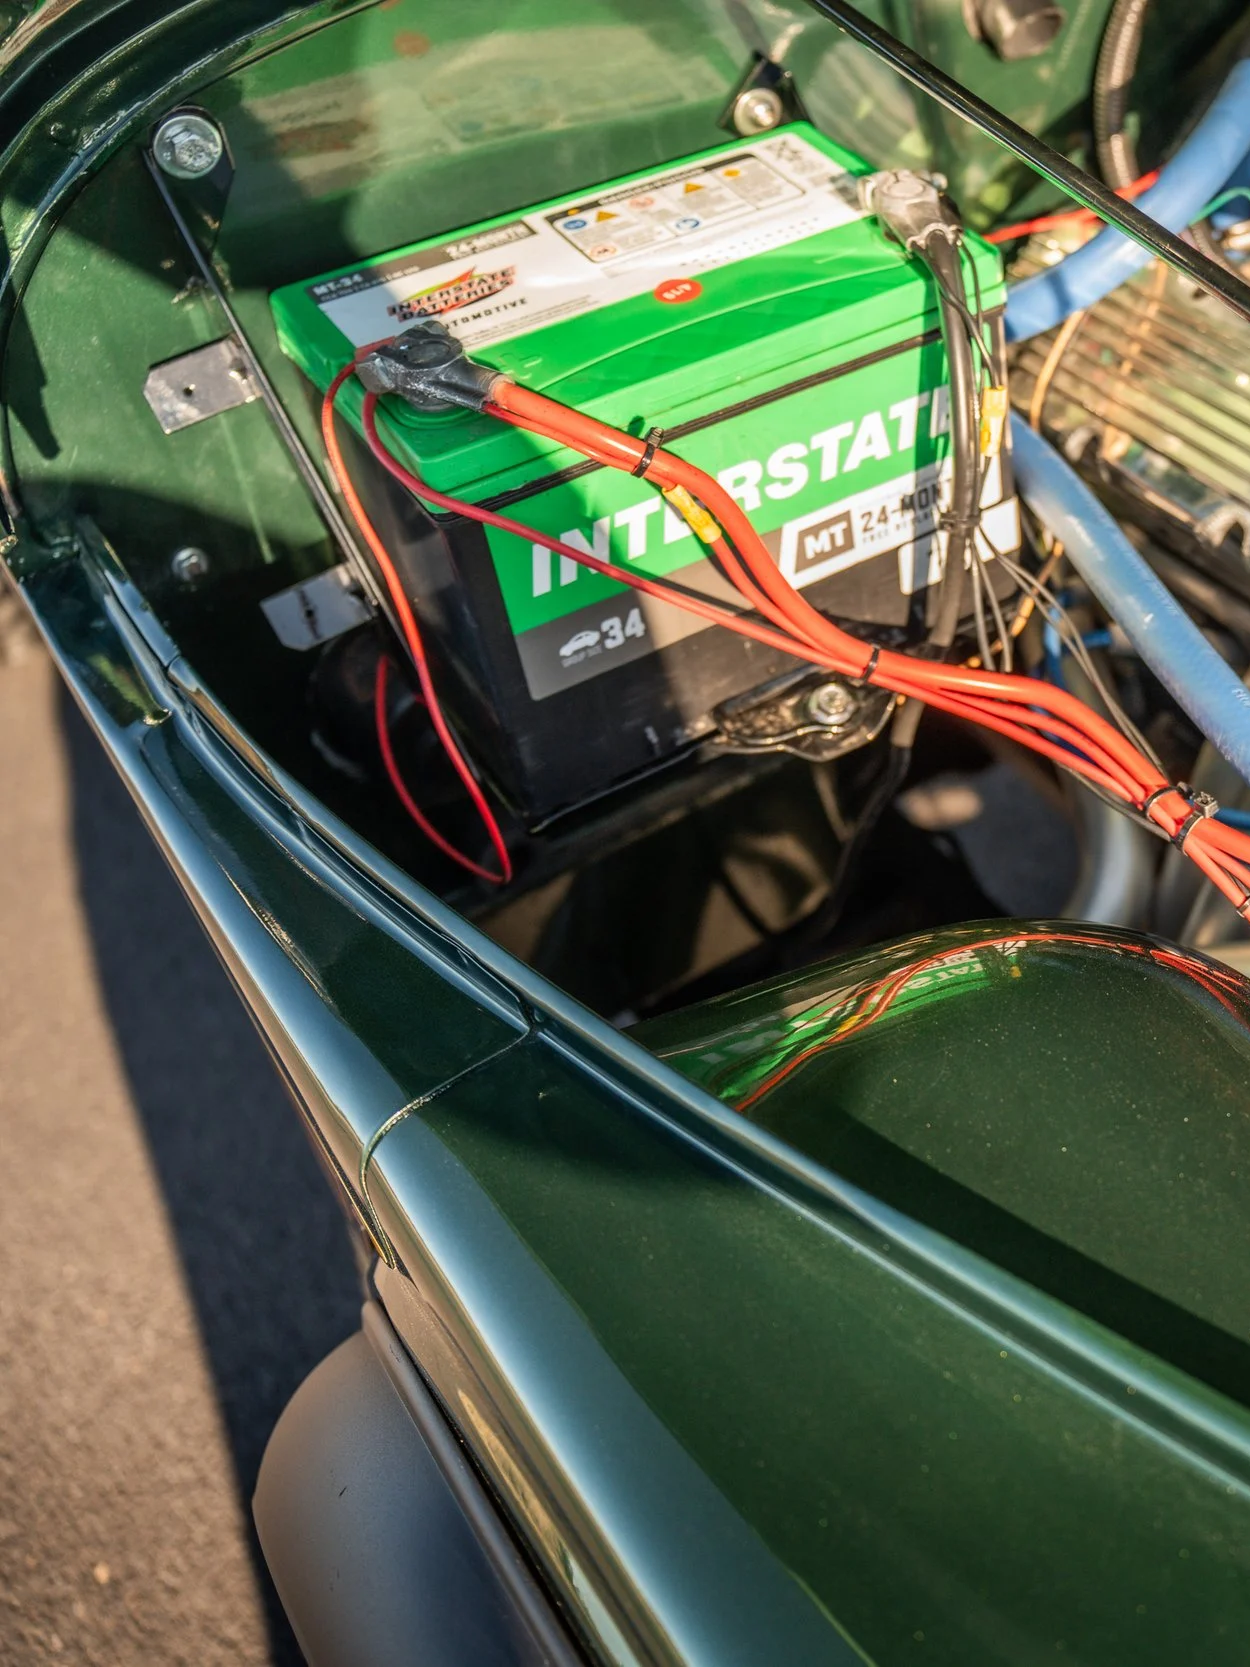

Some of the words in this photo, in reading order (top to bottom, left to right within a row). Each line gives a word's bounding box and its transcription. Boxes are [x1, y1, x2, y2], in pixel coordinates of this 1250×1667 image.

[390, 267, 511, 313] INTERSTATE
[401, 279, 511, 320] BATTERIES
[445, 298, 527, 330] UTOMOTIVE
[803, 521, 848, 560] MT
[600, 607, 646, 649] 34
